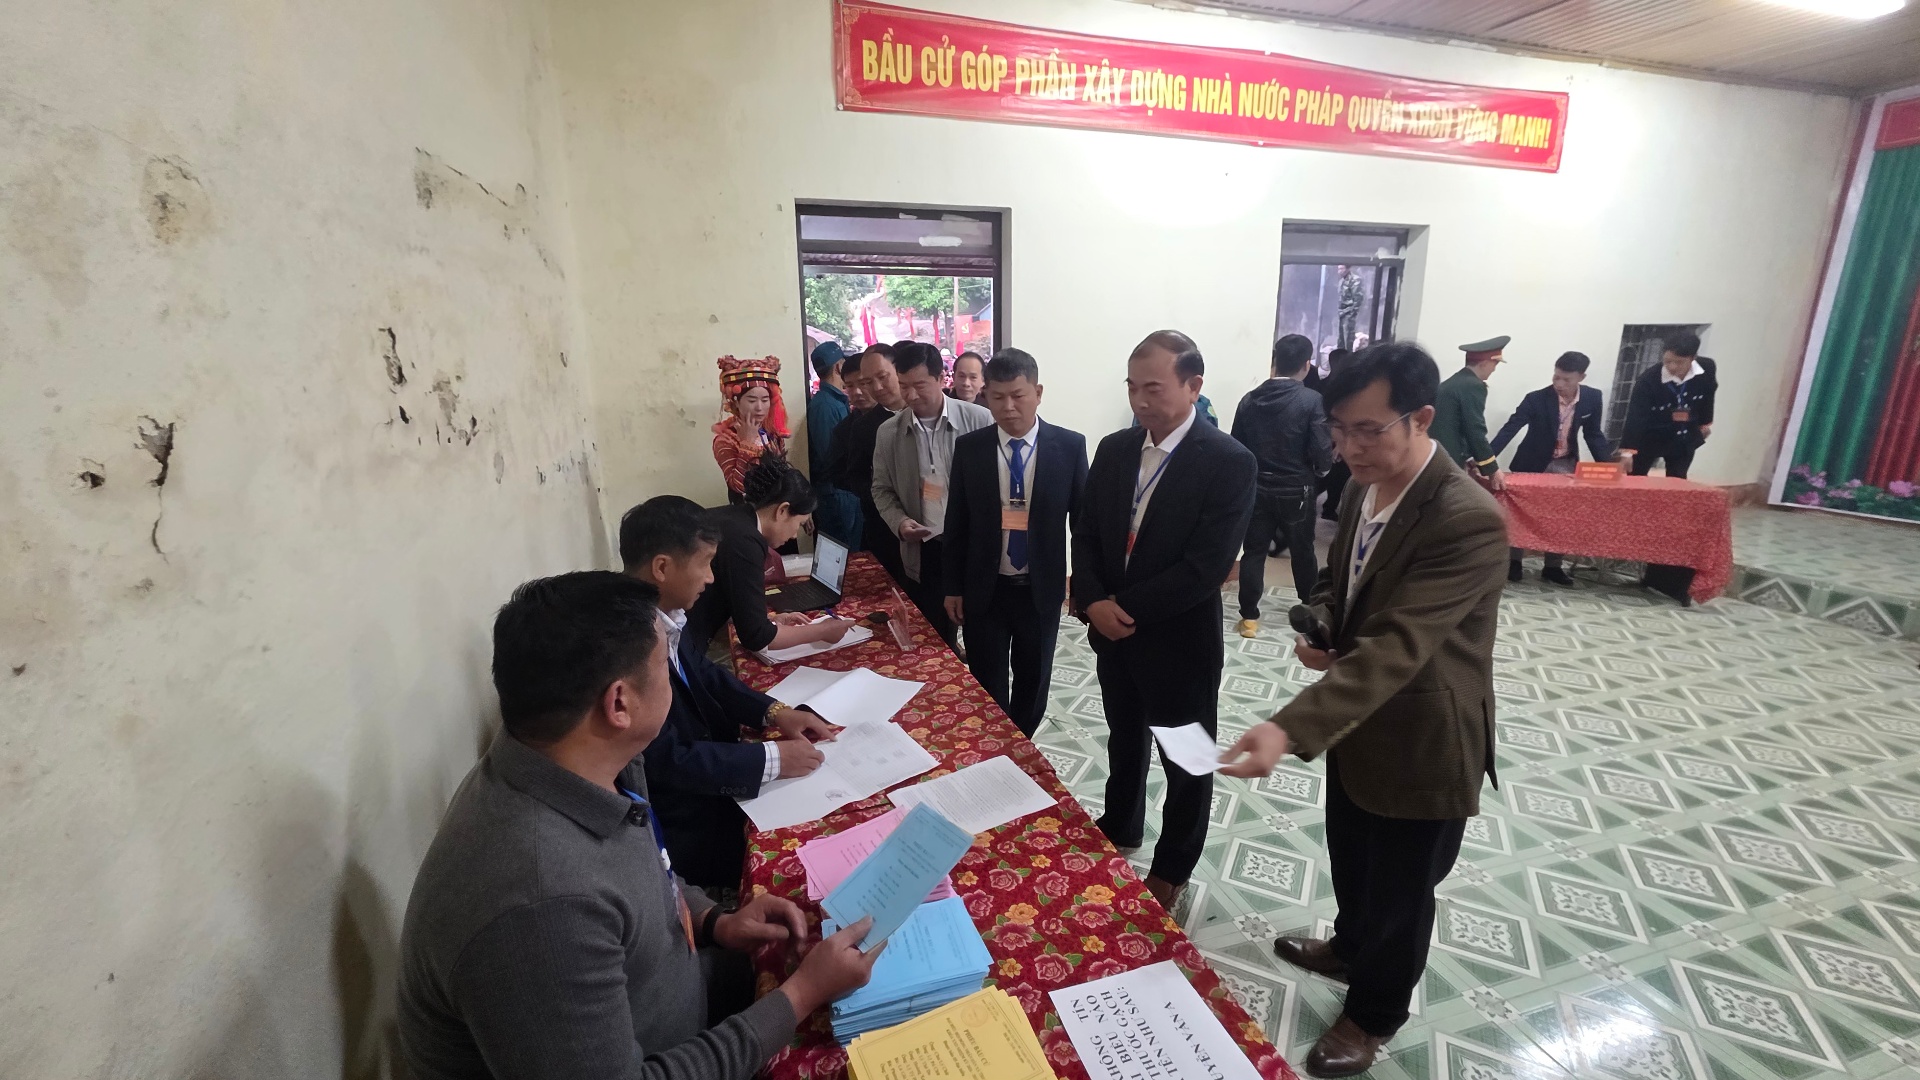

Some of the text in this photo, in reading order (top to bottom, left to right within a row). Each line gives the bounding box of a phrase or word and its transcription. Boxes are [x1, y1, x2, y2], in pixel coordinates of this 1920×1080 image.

[862, 27, 913, 85] BẦU
[920, 34, 956, 88] CỬ
[960, 44, 1008, 93] GÓP
[1014, 48, 1077, 101] PHẦN
[1082, 58, 1126, 106] XÂY
[1130, 68, 1187, 117] DỰNG
[1191, 72, 1233, 116] NHÀ
[1238, 78, 1290, 122] NƯỚC
[1294, 85, 1344, 127] PHÁP
[1406, 103, 1451, 138] XHCN
[1499, 113, 1553, 153] MẠNH!
[1070, 998, 1089, 1023] TÍN
[1086, 994, 1109, 1024] NÀO
[1100, 990, 1128, 1027] GẠCH
[1117, 986, 1140, 1015] SAU:
[1163, 1001, 1176, 1010] A
[1131, 1017, 1160, 1046] NHƯ
[1154, 1047, 1178, 1078] TÊN
